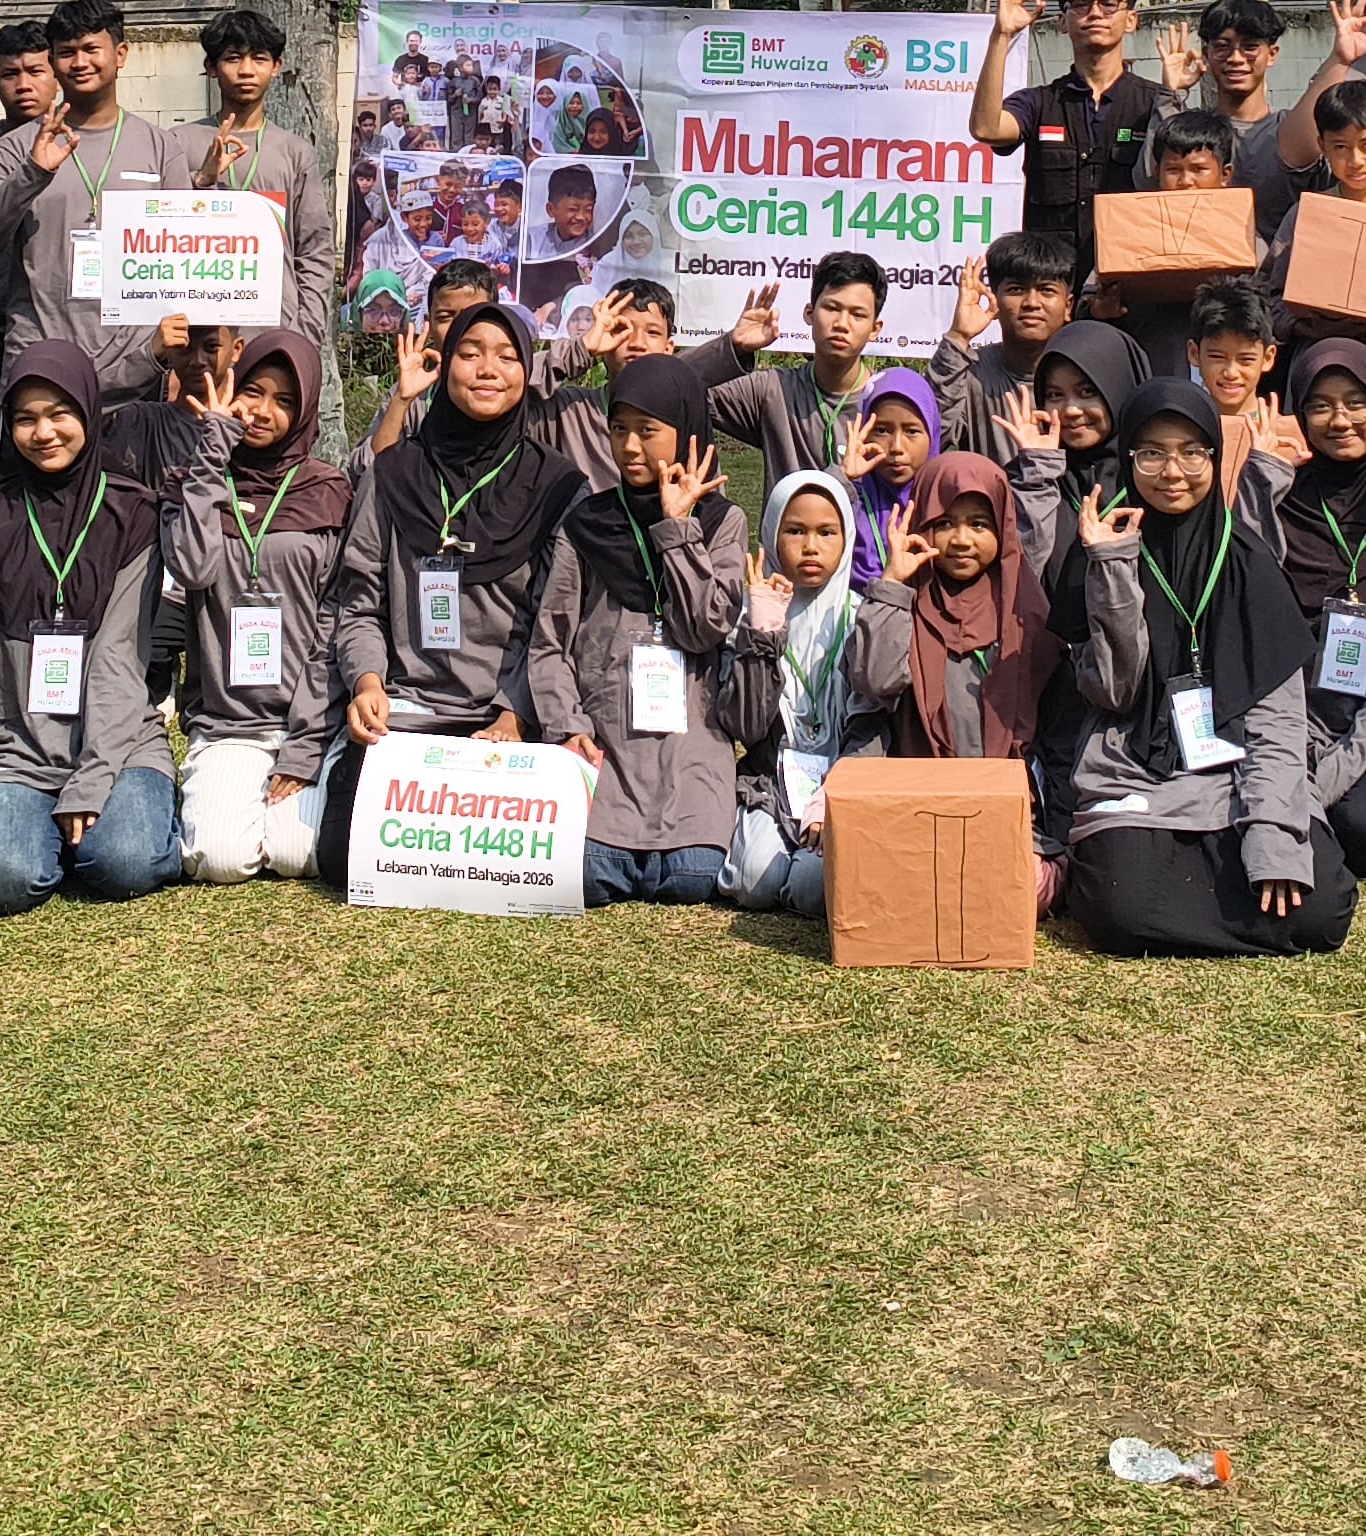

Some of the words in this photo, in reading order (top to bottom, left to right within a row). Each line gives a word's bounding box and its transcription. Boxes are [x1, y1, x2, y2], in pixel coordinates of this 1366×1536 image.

[417, 22, 494, 41] Berbagi
[500, 22, 556, 38] Ceria
[751, 37, 785, 53] BMT
[906, 39, 968, 74] BSI
[751, 54, 828, 72] Huwaiza
[701, 77, 735, 88] Koperasi
[736, 79, 766, 89] Simpan
[766, 80, 793, 90] Pinjam
[794, 80, 809, 89] dan
[859, 83, 889, 93] Syariah
[905, 79, 977, 92] MASLAHA
[681, 116, 993, 184] Muharram
[211, 200, 233, 212] BSI
[677, 183, 808, 236] Ceria
[821, 189, 940, 242] 1448
[952, 195, 992, 244] H
[122, 228, 259, 254] Muharram
[121, 258, 174, 280] Ceria
[180, 258, 234, 281] 1448
[239, 259, 258, 281] H
[674, 252, 766, 277] Lebaran
[771, 256, 816, 279] Yati
[886, 263, 934, 289] agia
[121, 289, 158, 300] Lebaran
[158, 289, 186, 299] Yatim
[188, 289, 232, 302] Bahagia
[233, 289, 259, 300] 2026
[507, 754, 535, 769] BSI
[384, 778, 558, 824] Muharram
[379, 818, 451, 852] Ceria
[459, 825, 524, 858] 1448
[530, 830, 554, 860] H
[376, 860, 427, 876] Lebaran
[430, 864, 465, 879] Yatim
[467, 867, 521, 886] Bahagia
[523, 871, 554, 886] 2026
[910, 810, 990, 964] II
